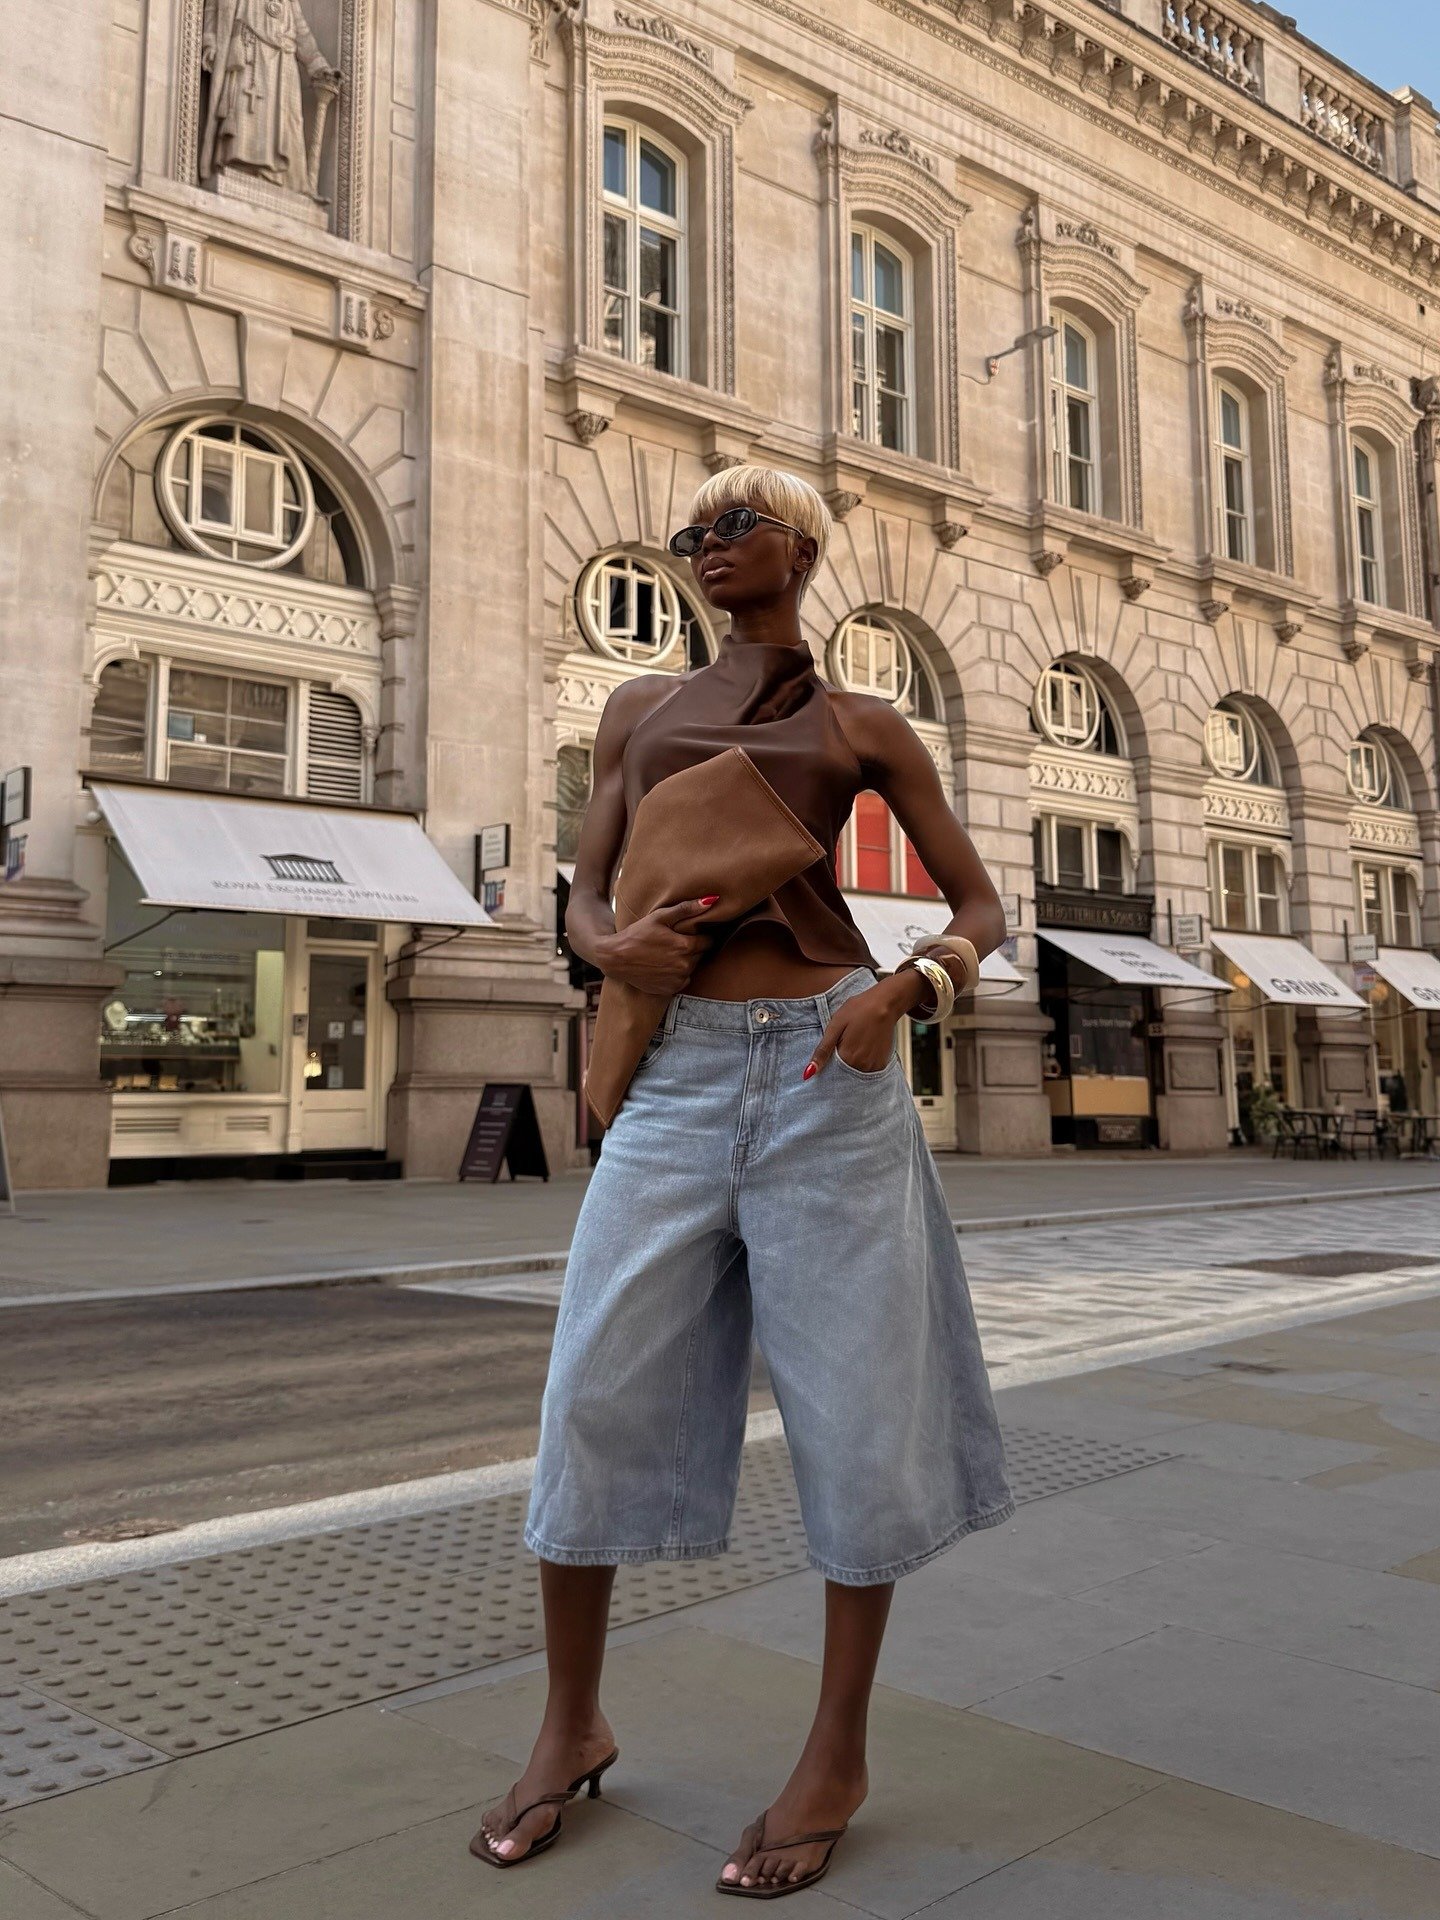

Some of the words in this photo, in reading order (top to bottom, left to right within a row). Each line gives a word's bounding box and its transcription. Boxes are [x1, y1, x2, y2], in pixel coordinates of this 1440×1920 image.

[210, 879, 260, 890] ROYAL
[265, 882, 343, 896] EXCHANGE
[1270, 977, 1340, 998] GRIND
